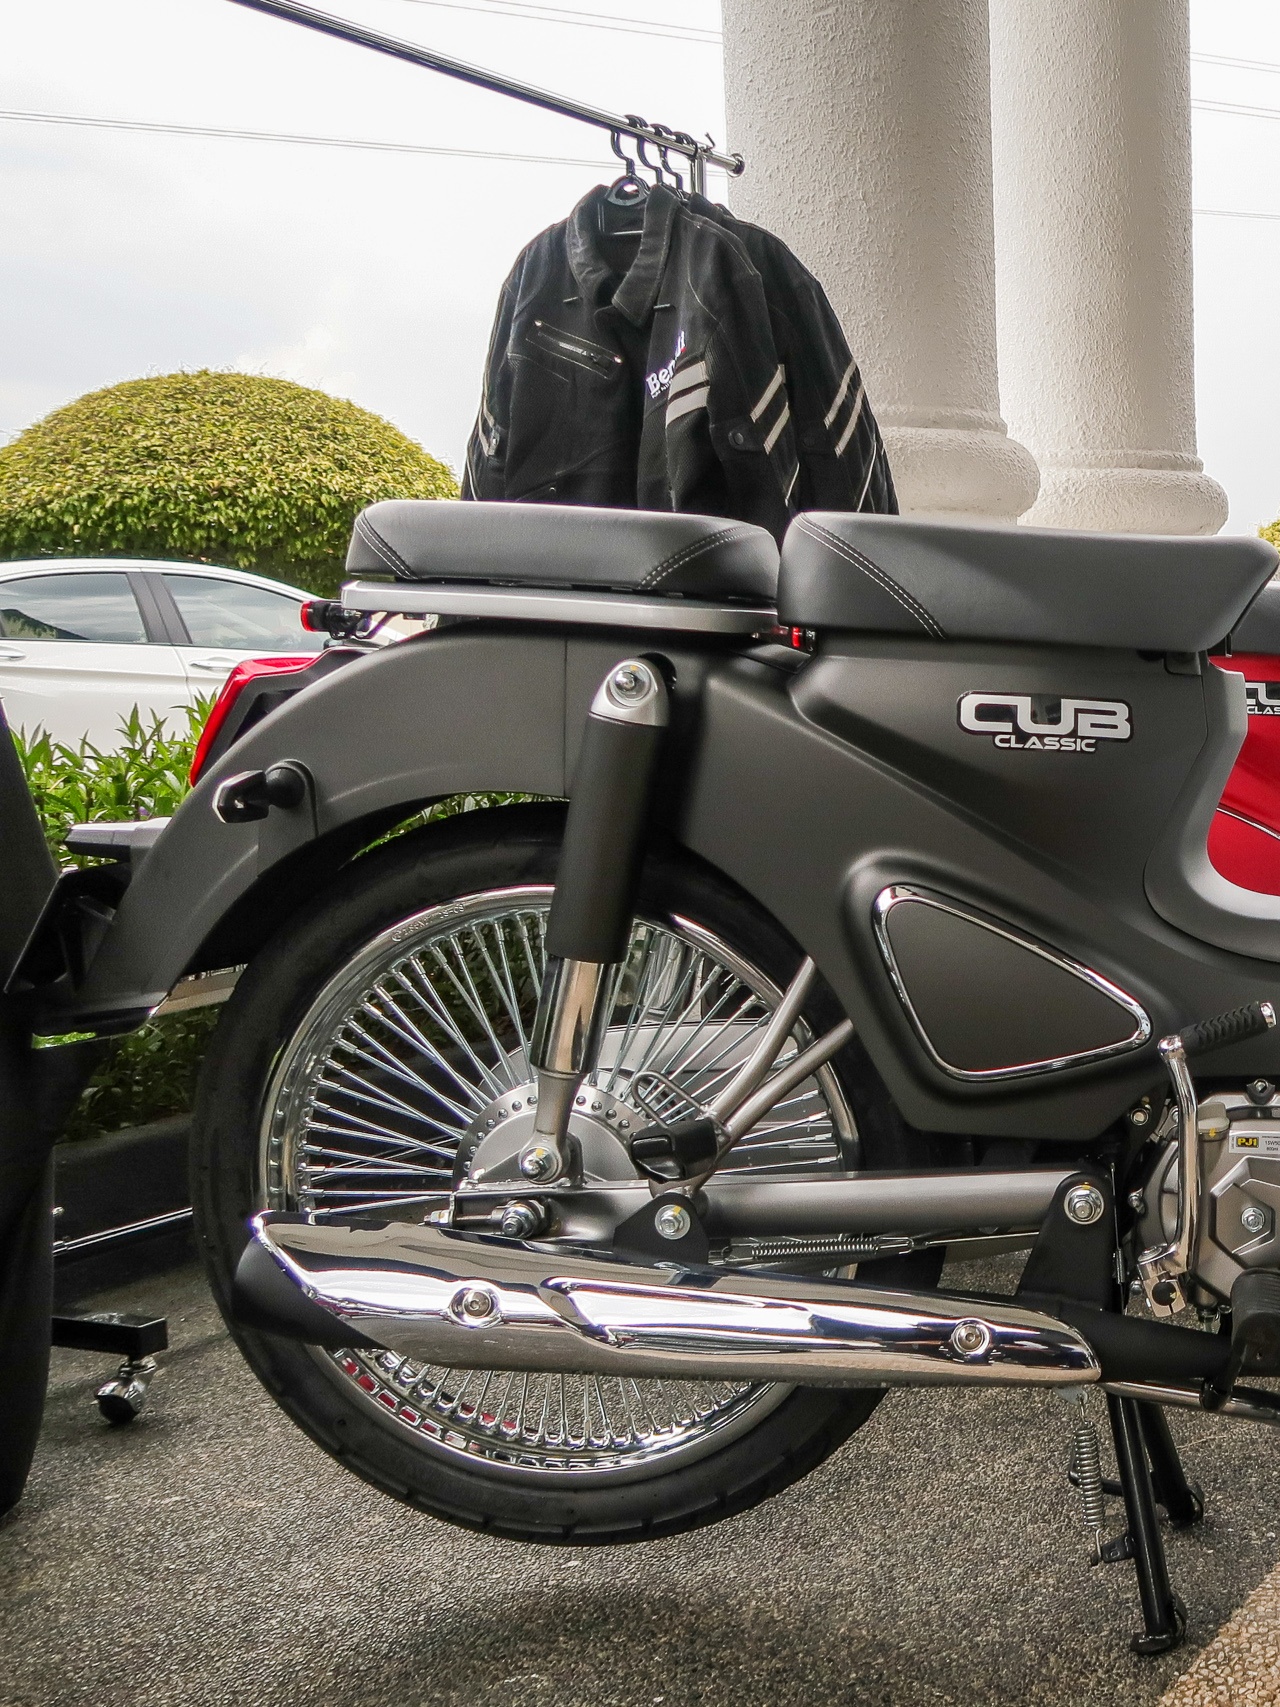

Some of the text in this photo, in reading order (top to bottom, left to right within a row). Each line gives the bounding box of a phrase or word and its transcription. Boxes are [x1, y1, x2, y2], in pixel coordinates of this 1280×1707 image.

[960, 694, 1131, 739] CUB
[995, 734, 1096, 752] CLASSIC
[1237, 1137, 1257, 1146] PJ1
